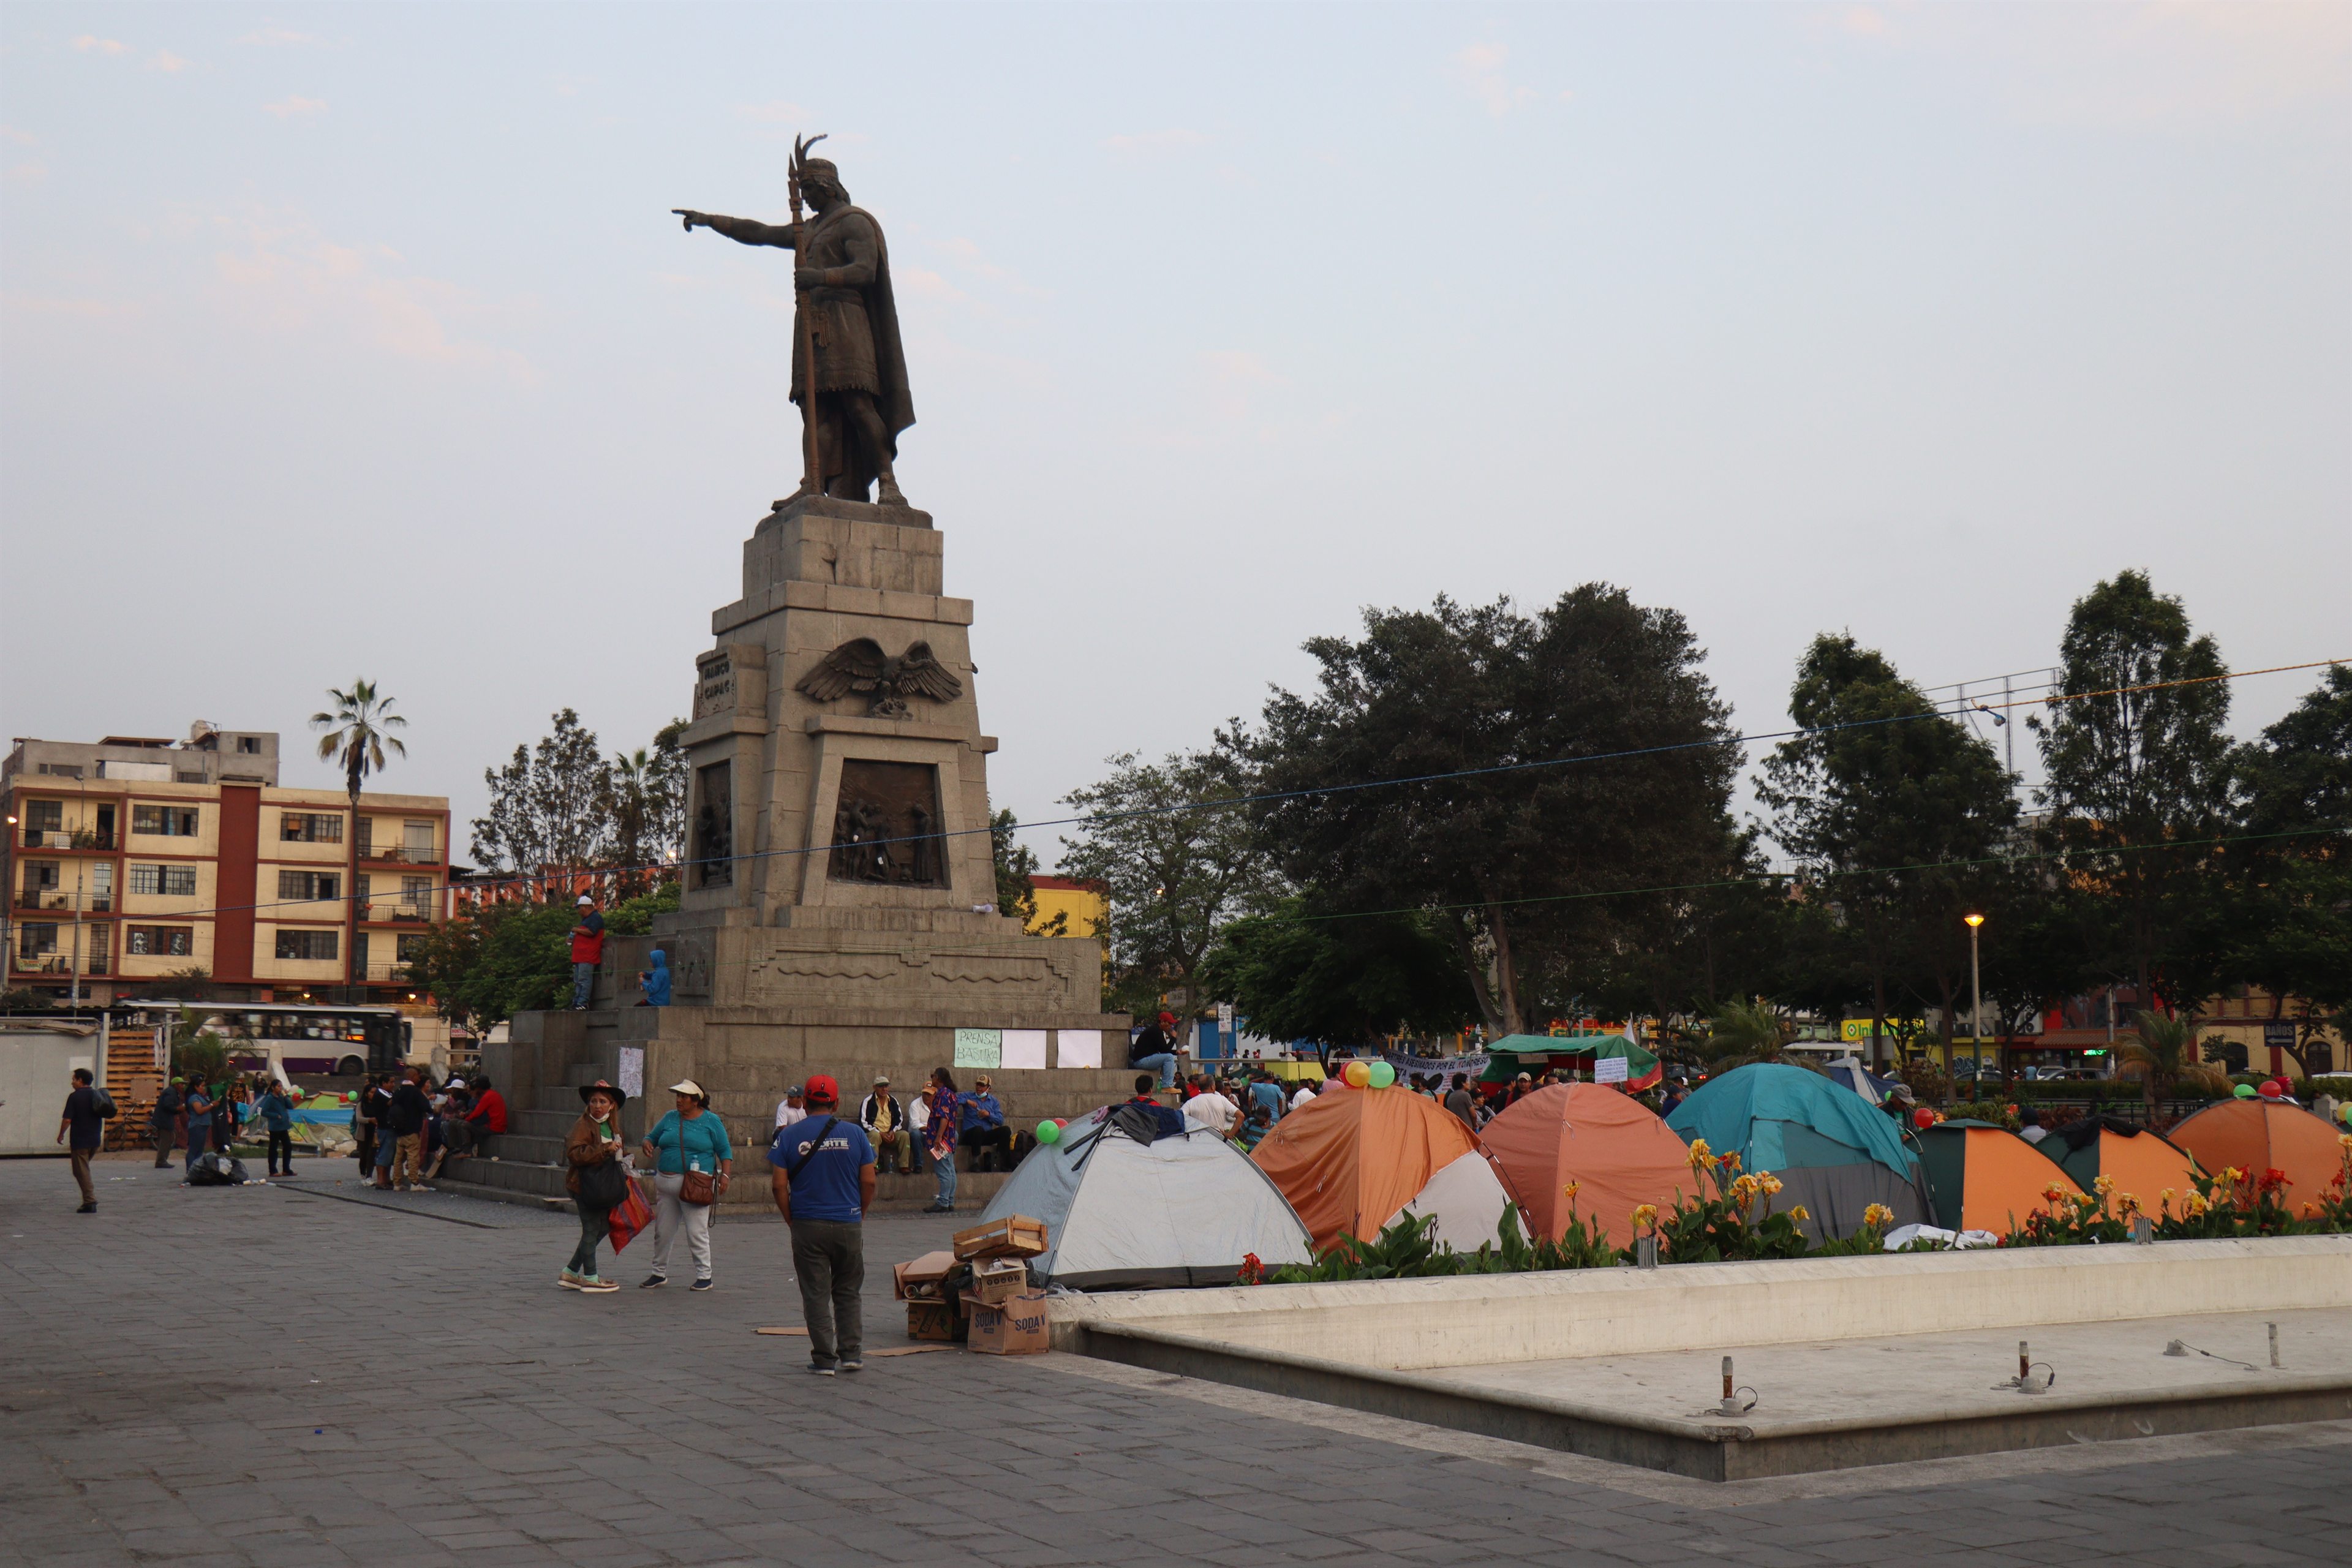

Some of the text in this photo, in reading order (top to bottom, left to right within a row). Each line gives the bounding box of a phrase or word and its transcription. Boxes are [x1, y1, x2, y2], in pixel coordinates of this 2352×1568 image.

[704, 660, 729, 680] MANCO
[704, 679, 729, 699] CAPAC
[2266, 1023, 2293, 1036] BAÑOS
[960, 1031, 998, 1046] PRENSA
[957, 1047, 998, 1063] BASURA
[1405, 1058, 1436, 1071] ASESINADOS
[1436, 1061, 1448, 1071] POR
[1448, 1061, 1456, 1071] EL
[975, 1311, 1002, 1328] SODA V
[1015, 1311, 1046, 1331] SODA V
